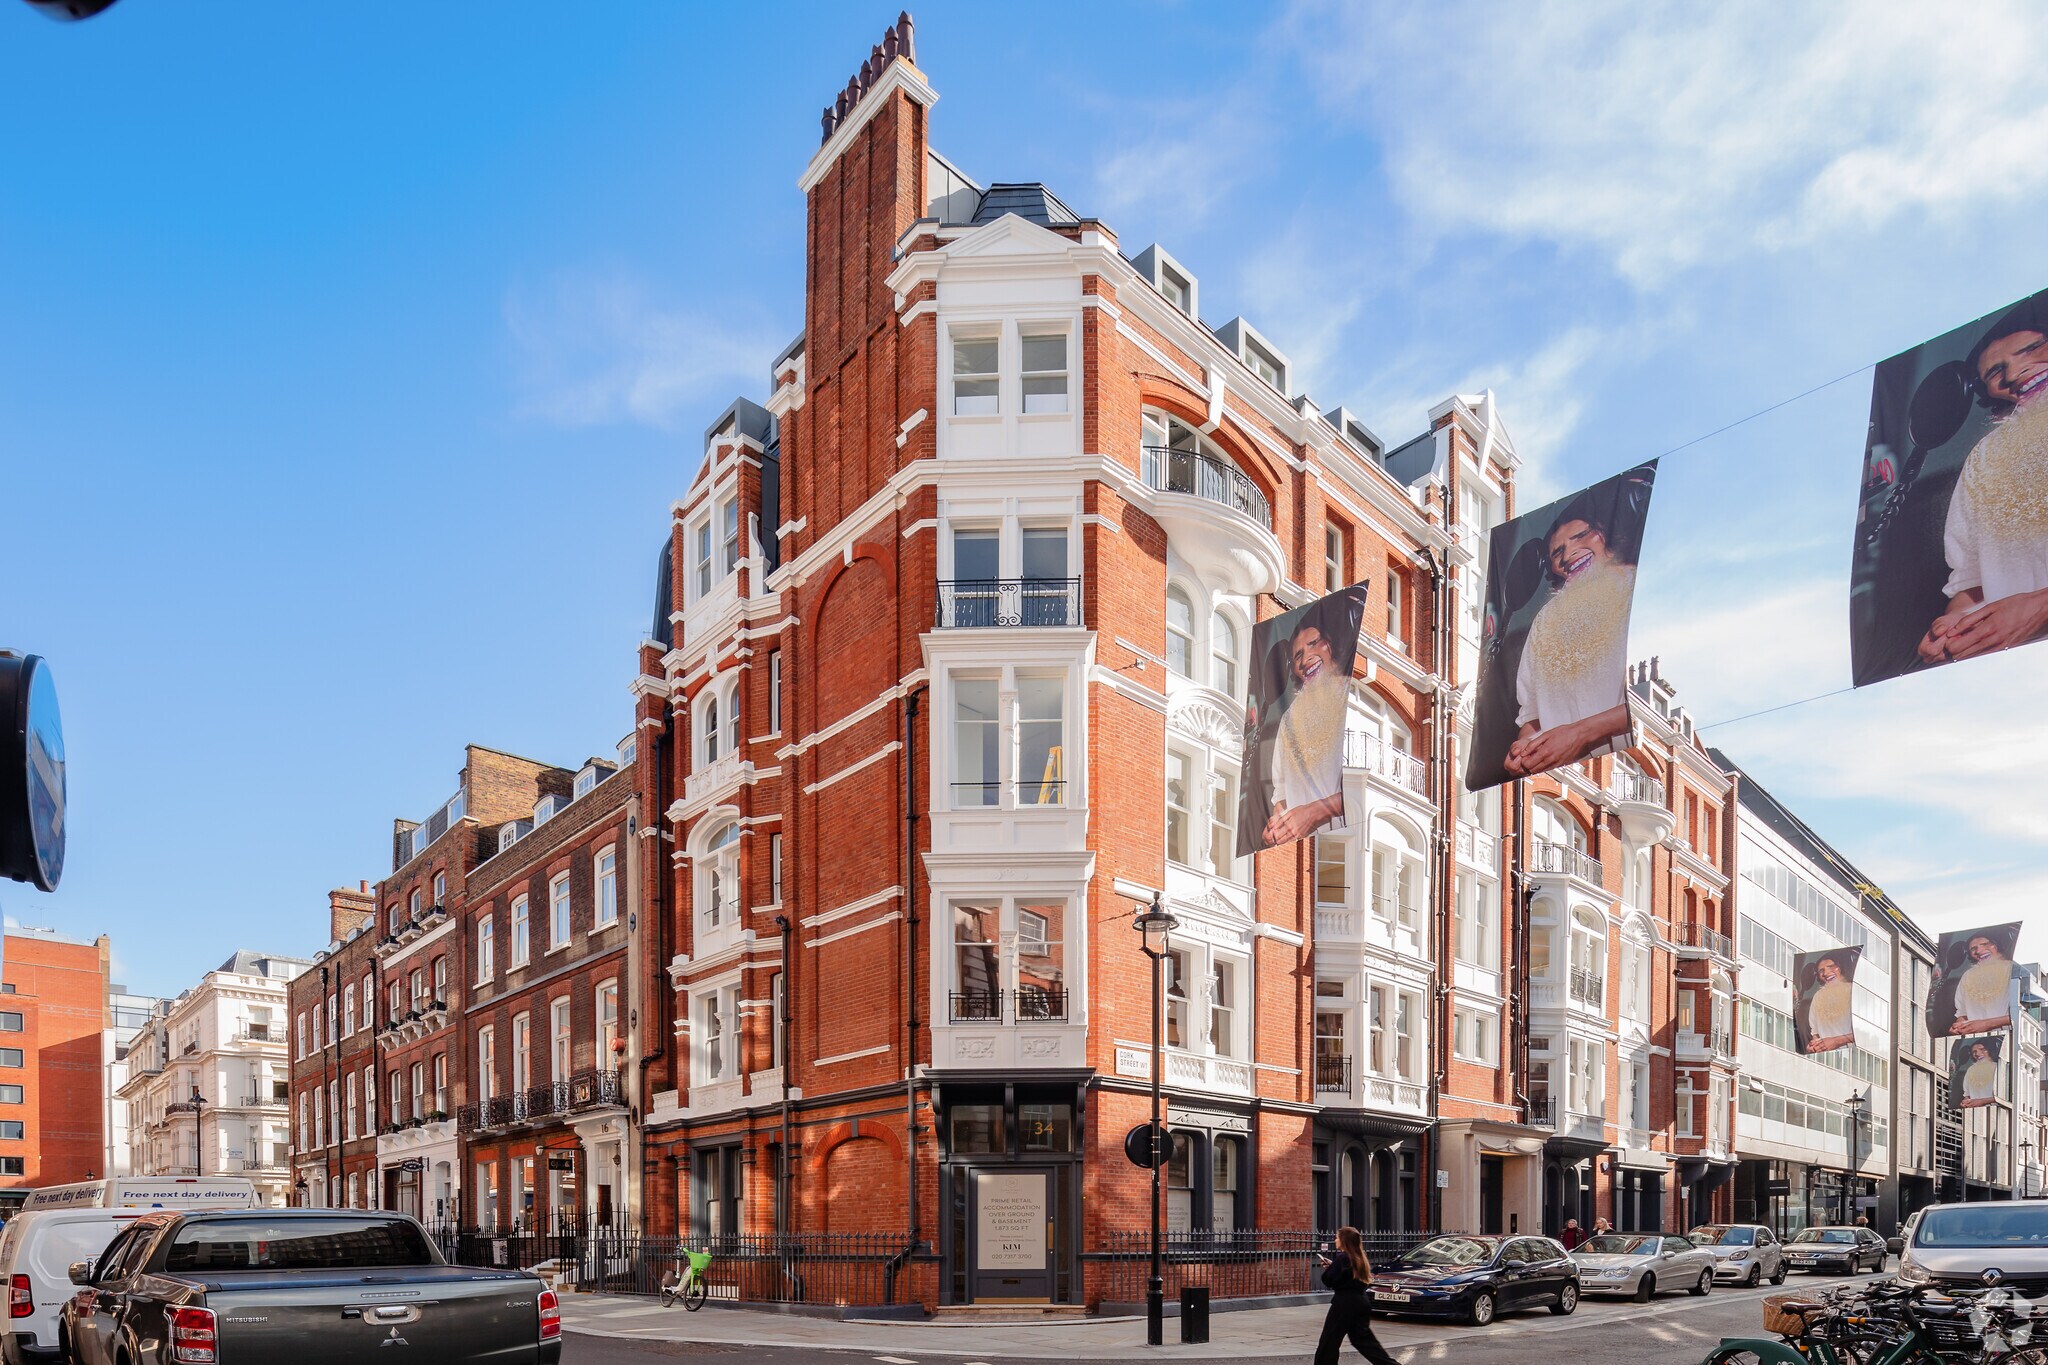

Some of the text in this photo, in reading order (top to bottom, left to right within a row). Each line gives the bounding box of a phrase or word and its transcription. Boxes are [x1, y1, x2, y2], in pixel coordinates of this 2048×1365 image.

[1120, 1051, 1134, 1059] CORK
[1120, 1059, 1138, 1068] STREET
[601, 1123, 609, 1133] 16
[1034, 1121, 1054, 1135] 34
[33, 1187, 104, 1204] Free next day delivery
